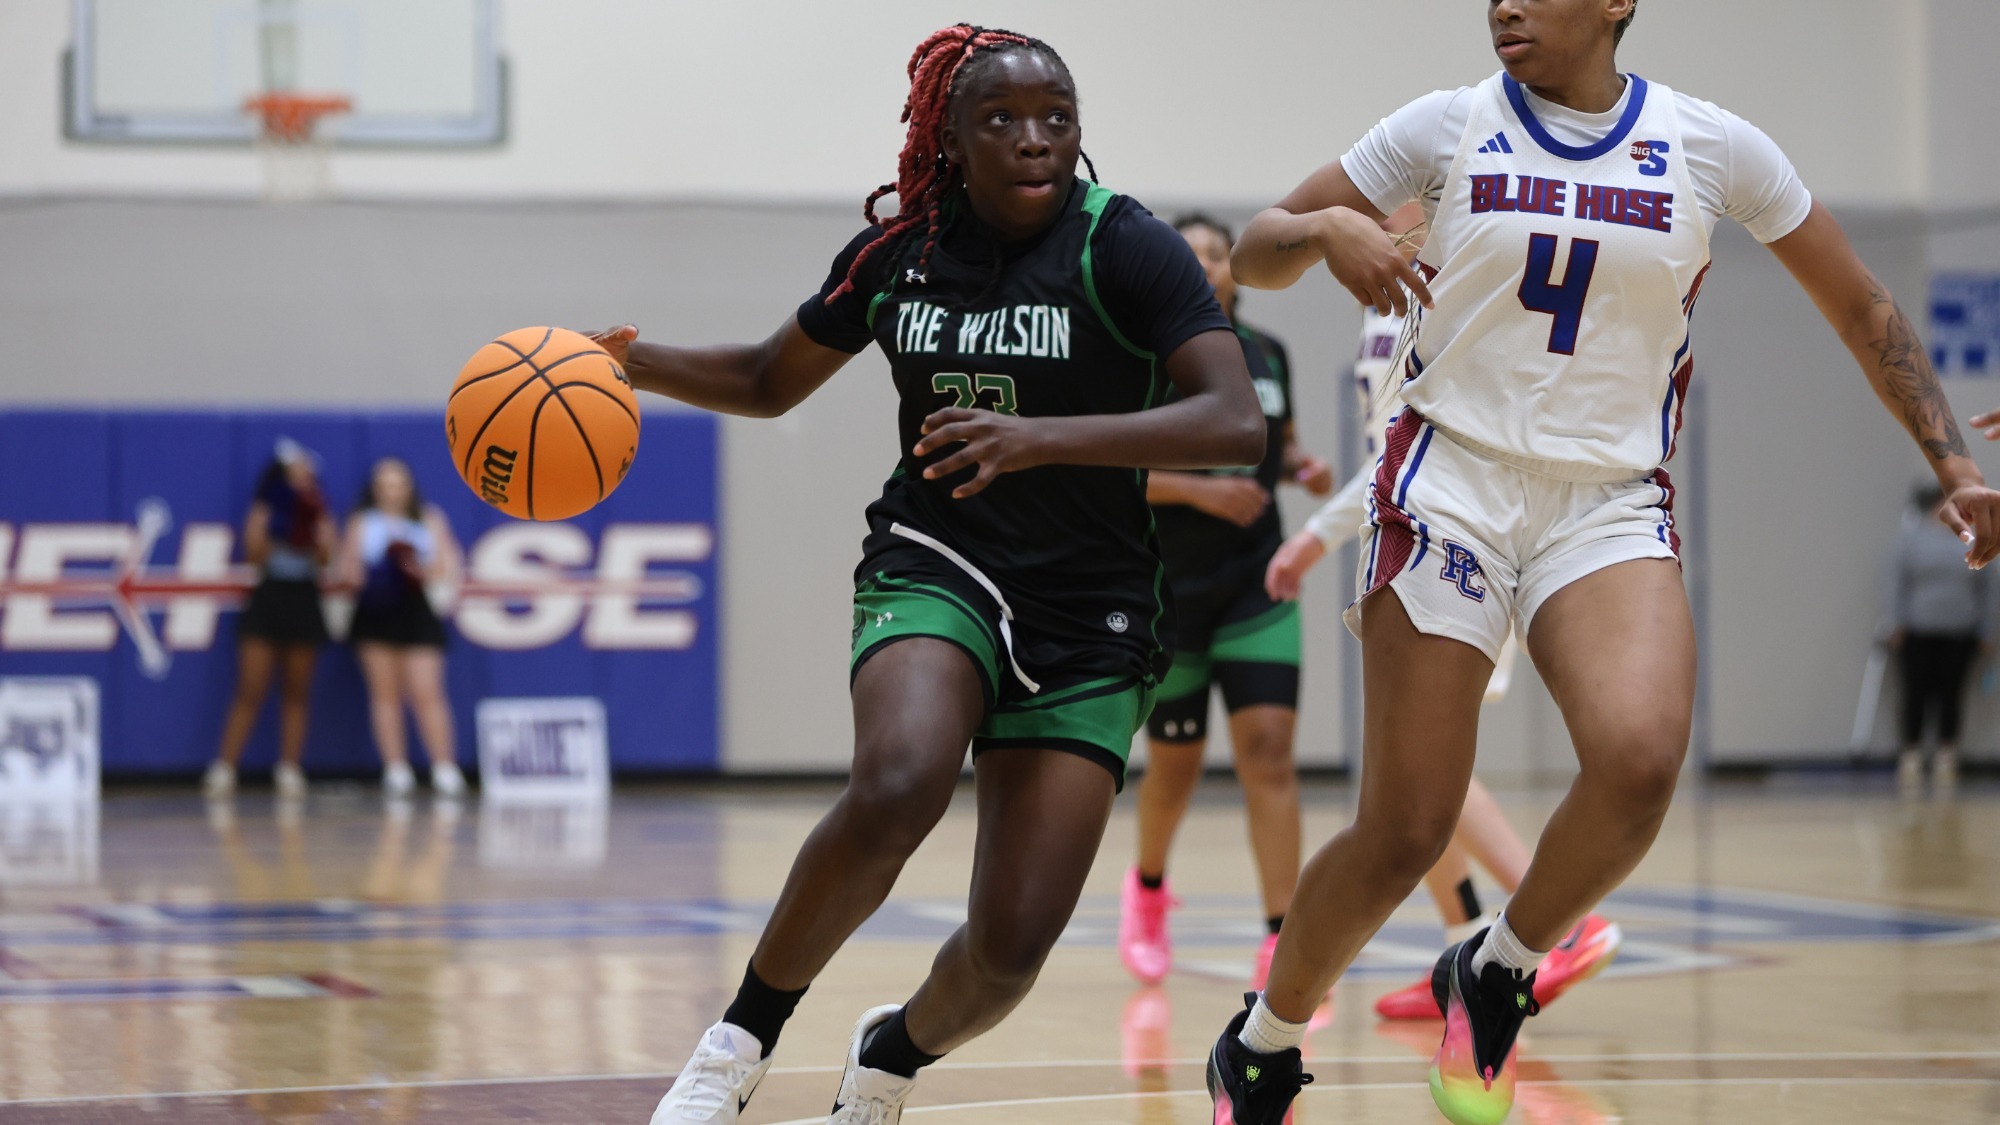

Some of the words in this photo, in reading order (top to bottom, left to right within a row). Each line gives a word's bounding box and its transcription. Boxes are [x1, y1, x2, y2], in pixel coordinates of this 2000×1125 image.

[1630, 145, 1650, 156] BIG
[1638, 140, 1669, 177] S
[1469, 173, 1567, 216] BLUE
[1573, 182, 1674, 233] HOSE
[1517, 232, 1600, 356] 4
[897, 301, 949, 353] THE
[957, 304, 1070, 359] WILSON
[480, 444, 519, 506] Wil
[0, 522, 140, 650] E
